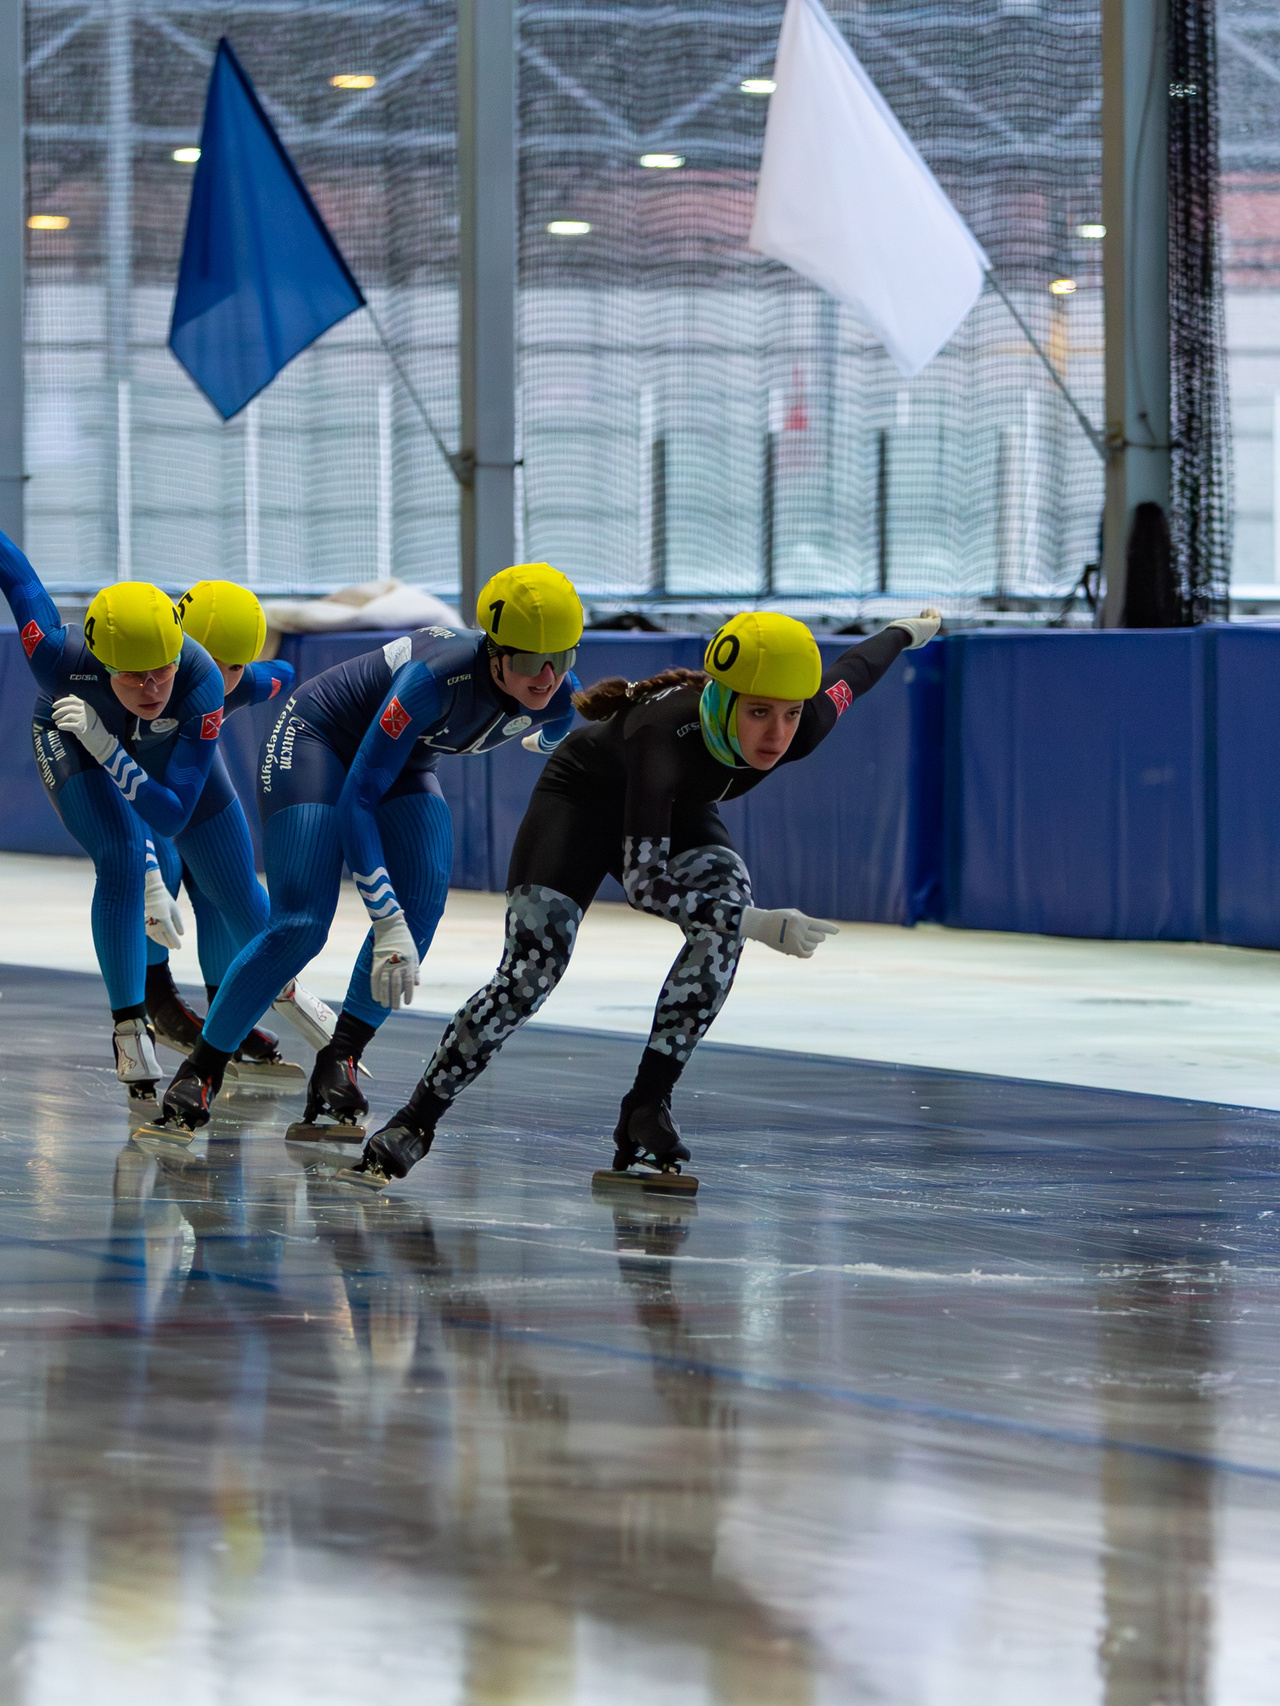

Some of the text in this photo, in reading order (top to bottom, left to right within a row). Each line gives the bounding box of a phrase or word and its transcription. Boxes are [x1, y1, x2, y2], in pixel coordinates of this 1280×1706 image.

[84, 616, 96, 650] 4
[489, 599, 505, 634] 1
[705, 628, 740, 672] 10
[261, 696, 297, 793] Петербург
[280, 716, 305, 770] Санкт
